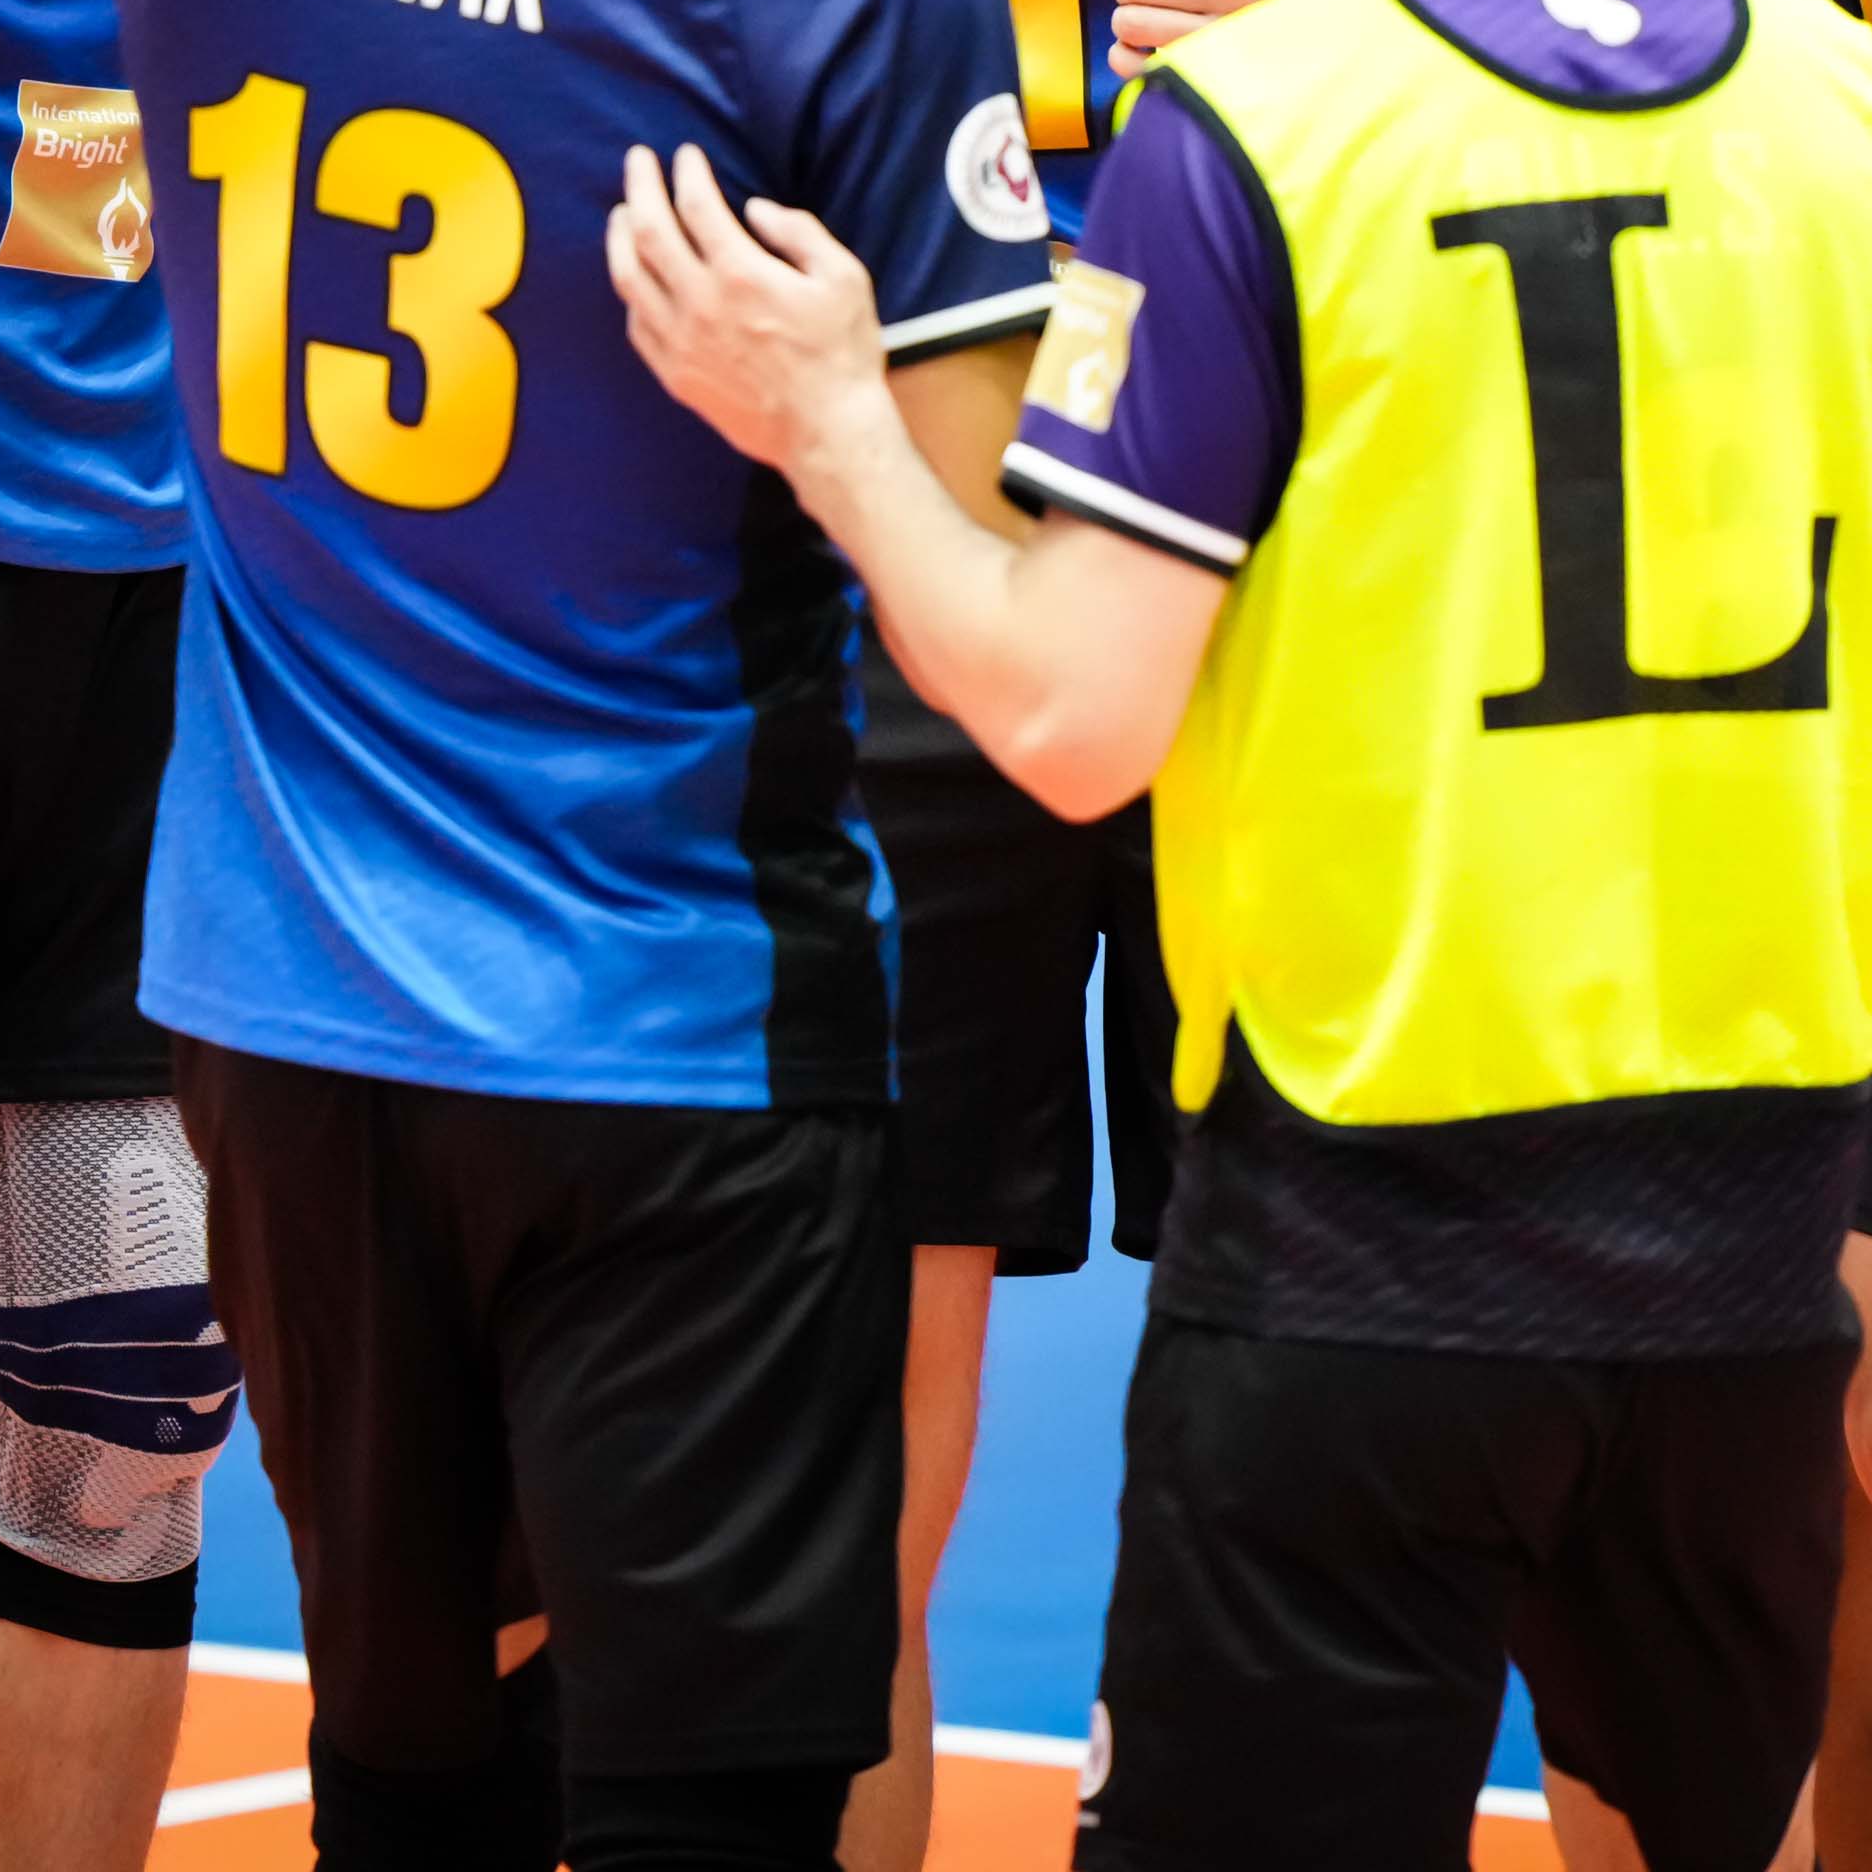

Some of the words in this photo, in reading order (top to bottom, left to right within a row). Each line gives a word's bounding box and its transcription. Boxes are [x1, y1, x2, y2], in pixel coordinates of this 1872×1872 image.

[33, 127, 130, 169] Bright
[188, 73, 526, 511] 13
[1430, 192, 1836, 732] L
